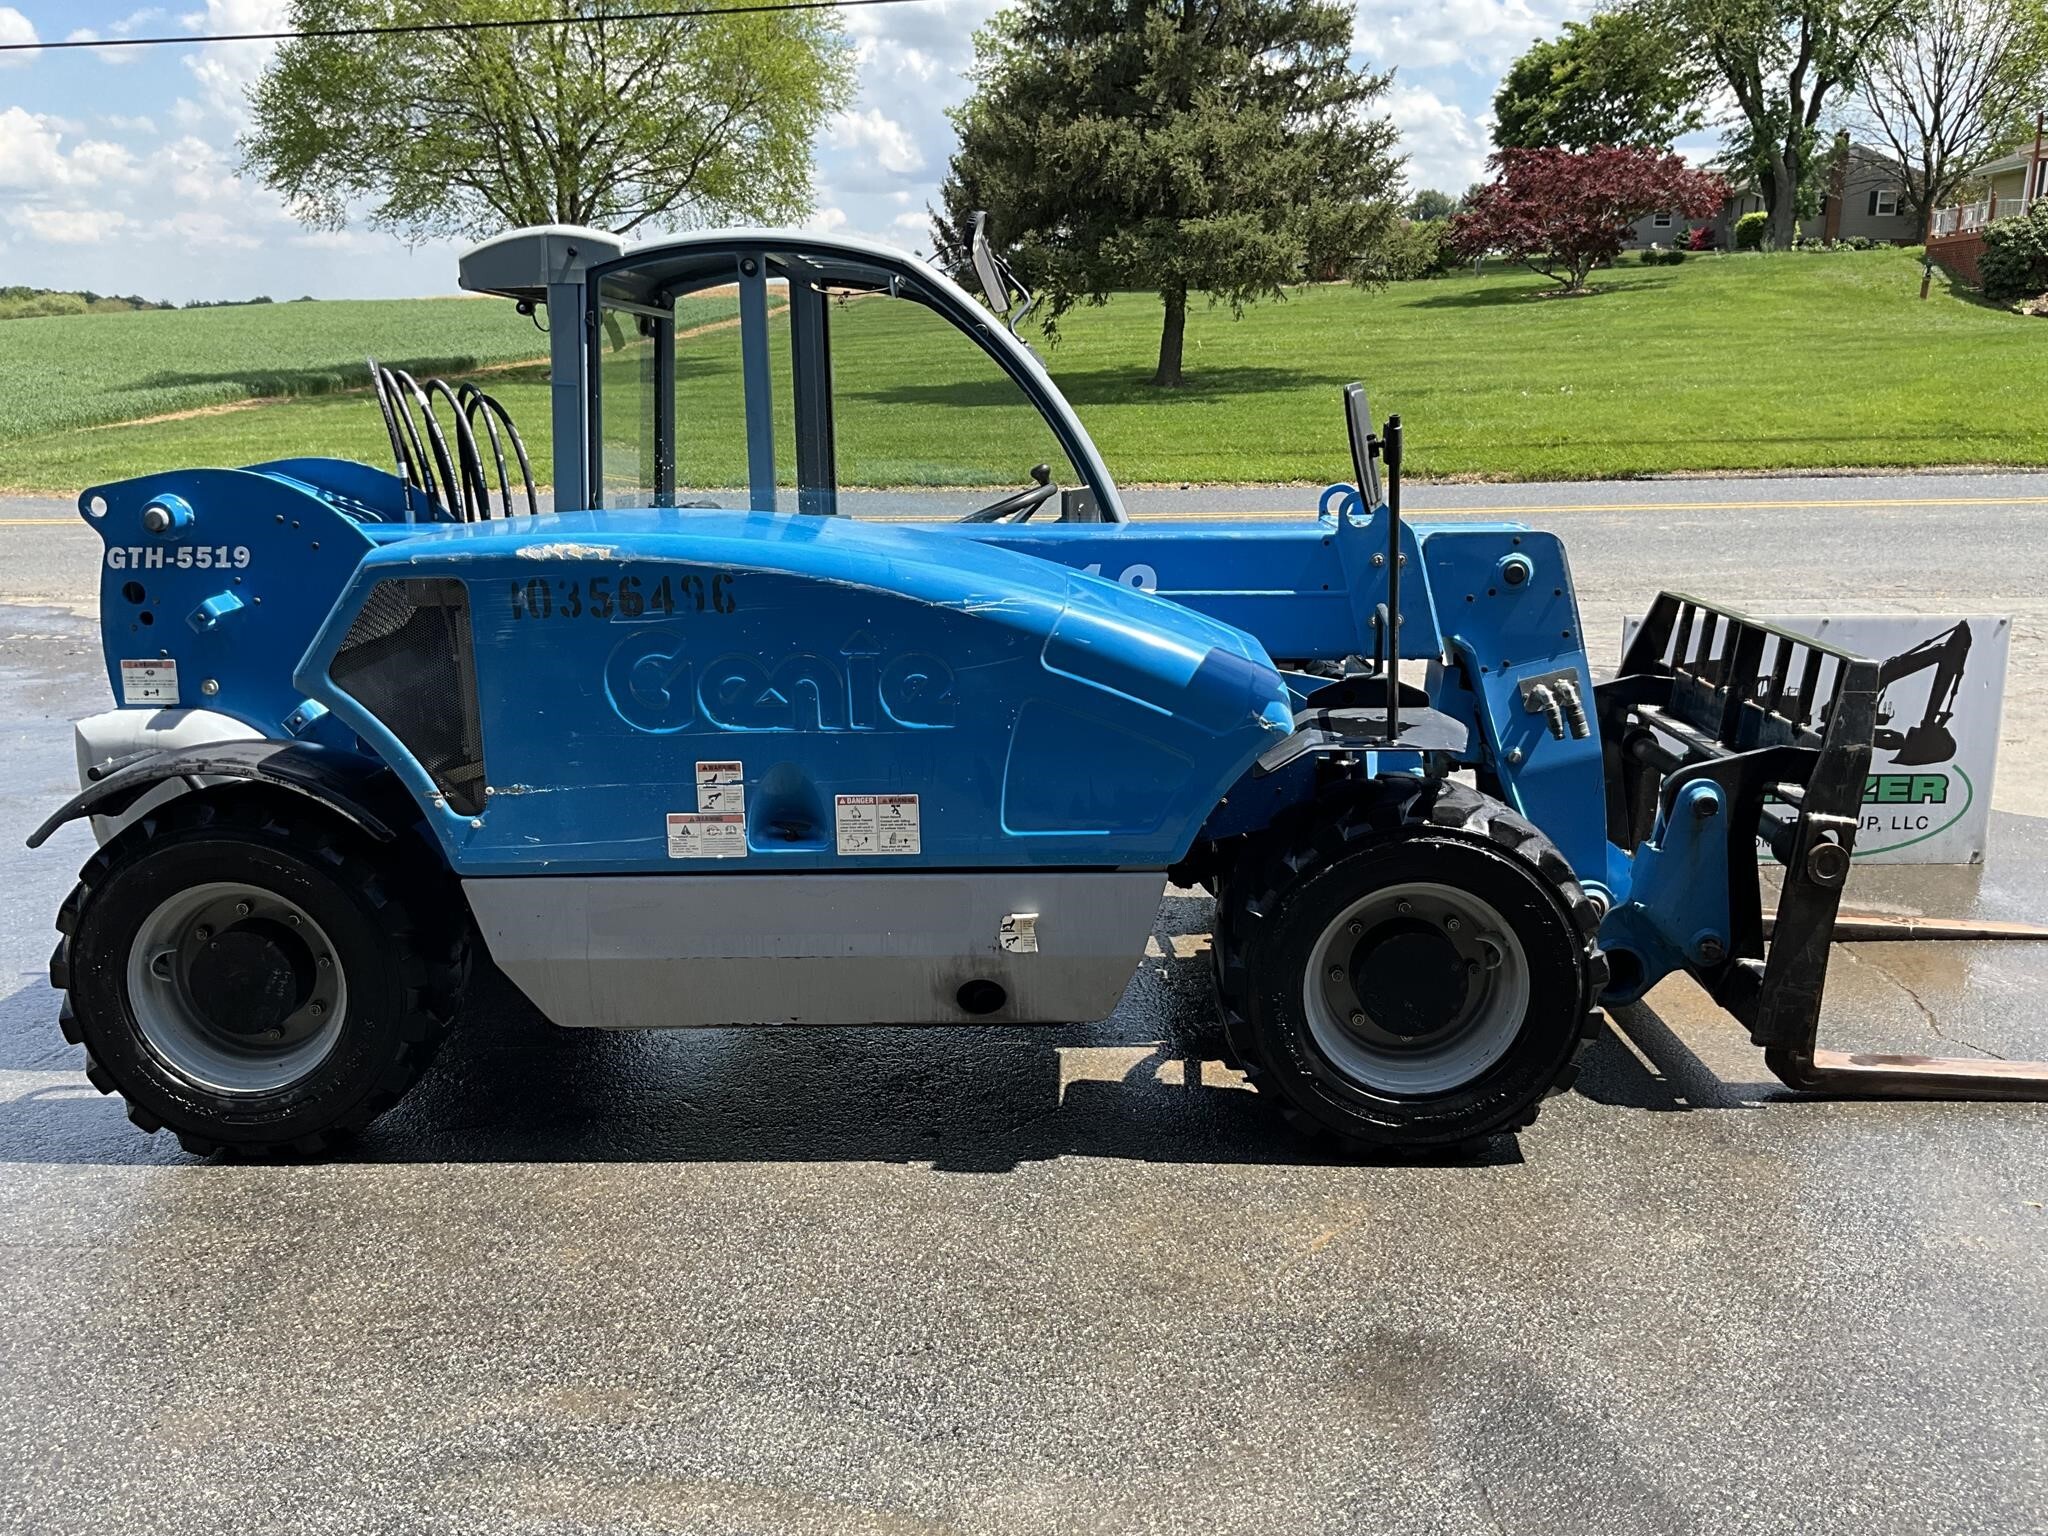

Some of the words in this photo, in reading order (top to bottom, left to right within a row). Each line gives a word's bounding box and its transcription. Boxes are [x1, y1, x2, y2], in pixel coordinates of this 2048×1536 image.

[106, 545, 251, 570] GTH-5519
[604, 628, 956, 734] Genie
[1856, 816, 1881, 832] UP,
[1891, 815, 1929, 830] LLC
